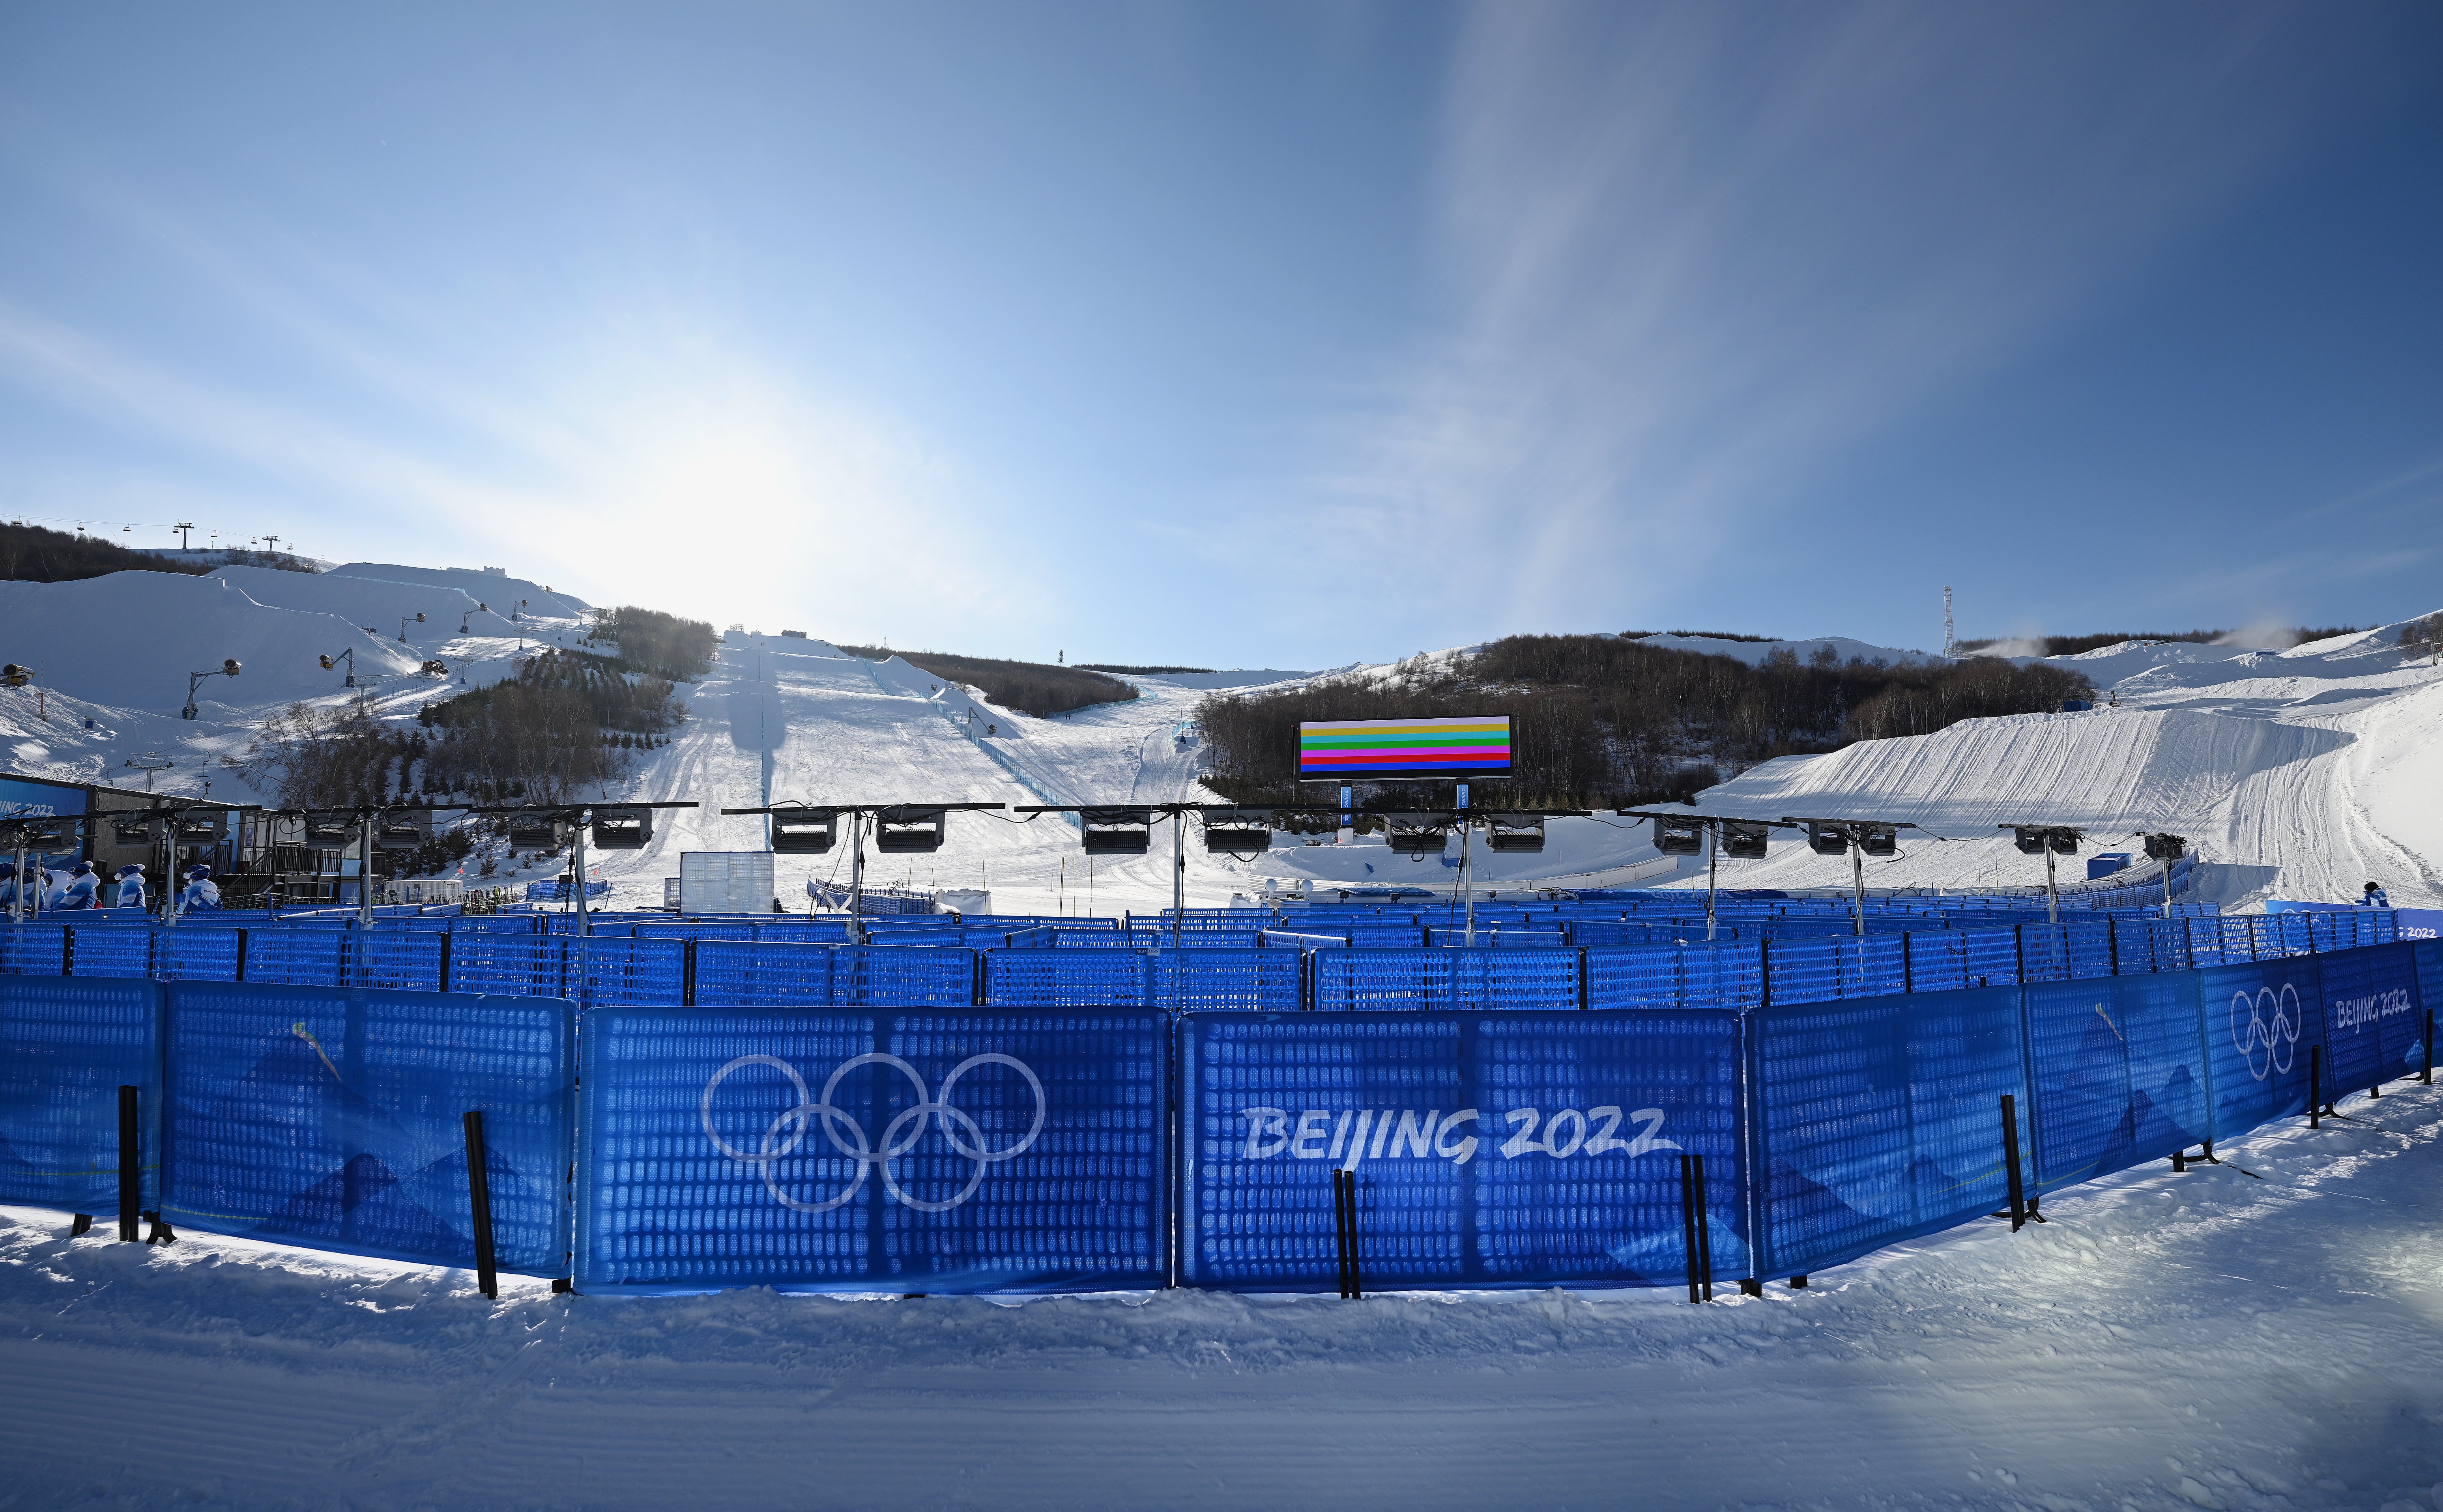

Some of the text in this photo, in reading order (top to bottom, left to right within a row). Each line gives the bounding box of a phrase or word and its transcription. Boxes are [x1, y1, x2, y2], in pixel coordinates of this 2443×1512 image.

[24, 803, 57, 817] 2022
[2407, 927, 2439, 938] 2022
[2335, 988, 2411, 1034] BEIJING 2022
[1242, 1106, 1684, 1172] BEIJING 2022
